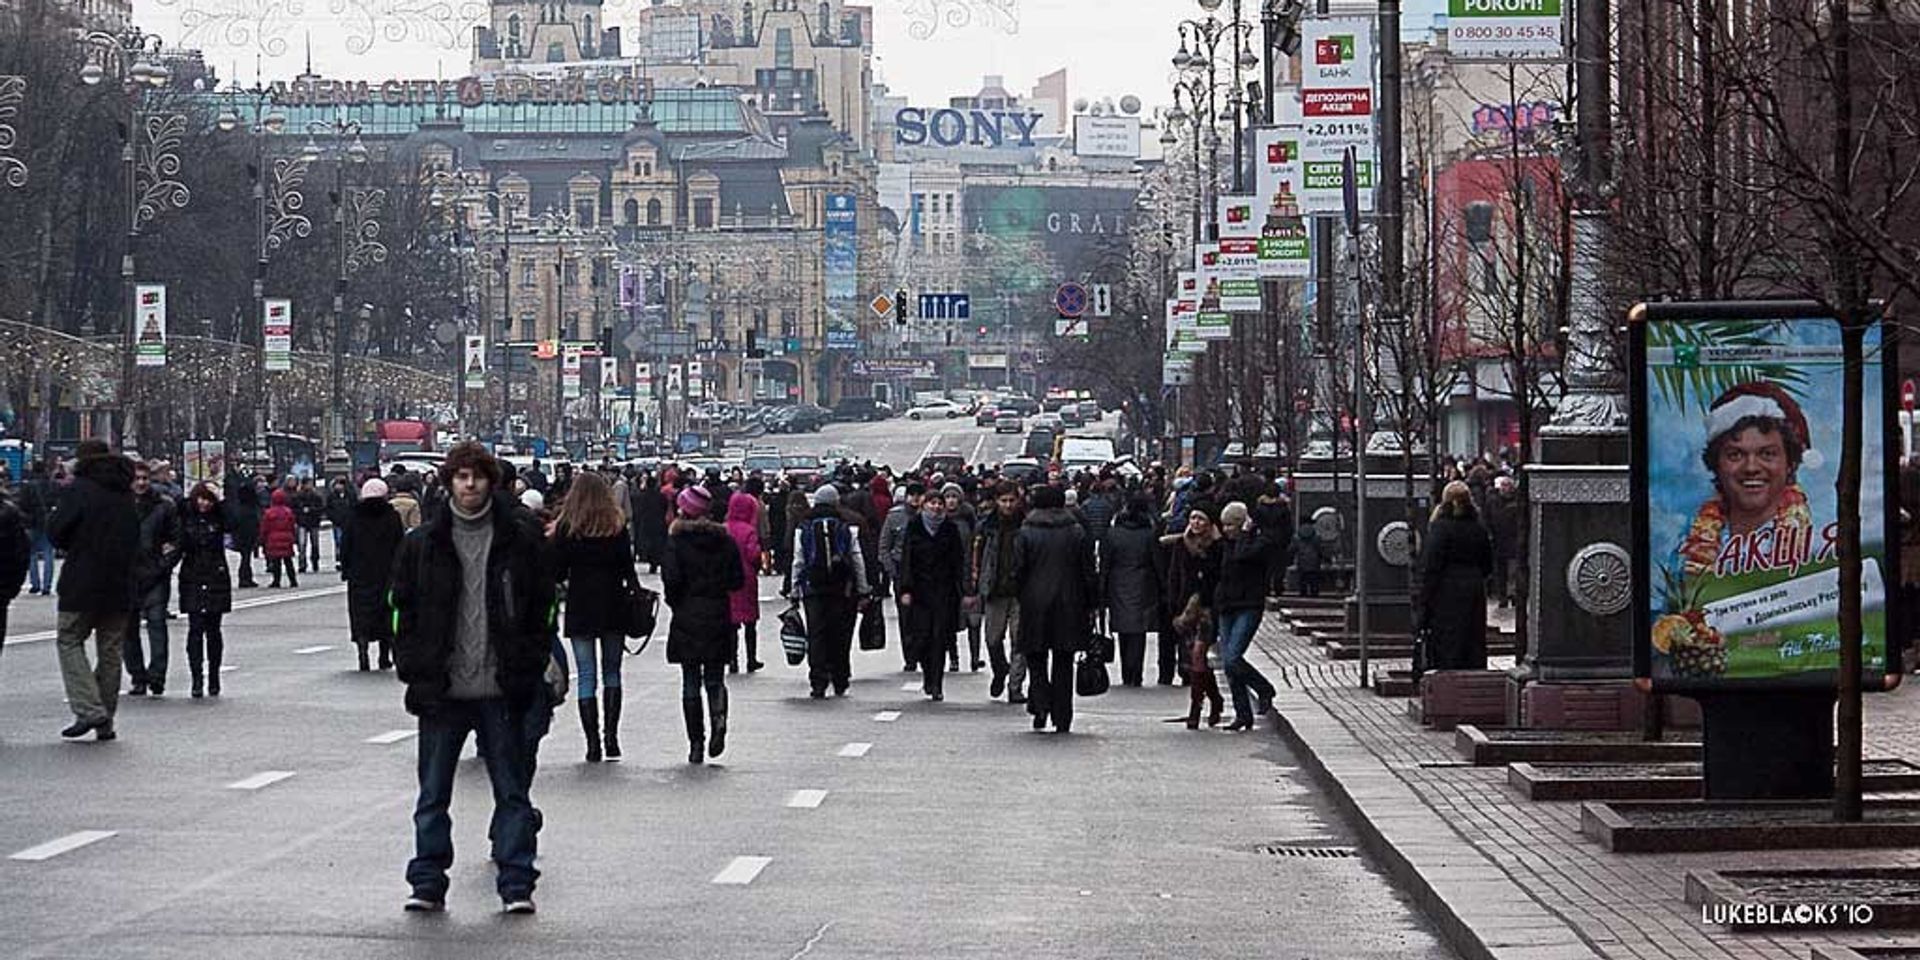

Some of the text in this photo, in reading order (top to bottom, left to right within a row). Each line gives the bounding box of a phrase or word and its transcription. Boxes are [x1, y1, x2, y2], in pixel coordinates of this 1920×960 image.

[1464, 0, 1543, 11] РОКОМ!
[1454, 26, 1555, 38] 0 800 30 45 45
[1320, 68, 1352, 78] БАНК
[271, 80, 453, 106] ARENA CITY
[492, 77, 591, 105] АРЕНА
[1305, 93, 1368, 104] ДЕПОЗИТНА
[1321, 102, 1353, 112] АКЦІЯ
[895, 106, 1043, 148] SONY
[1307, 123, 1368, 137] +2,011%
[1309, 163, 1367, 174] СВЯТВІ
[1308, 176, 1368, 187] ВІДСОИ
[1715, 520, 1839, 579] АКЦІЯ
